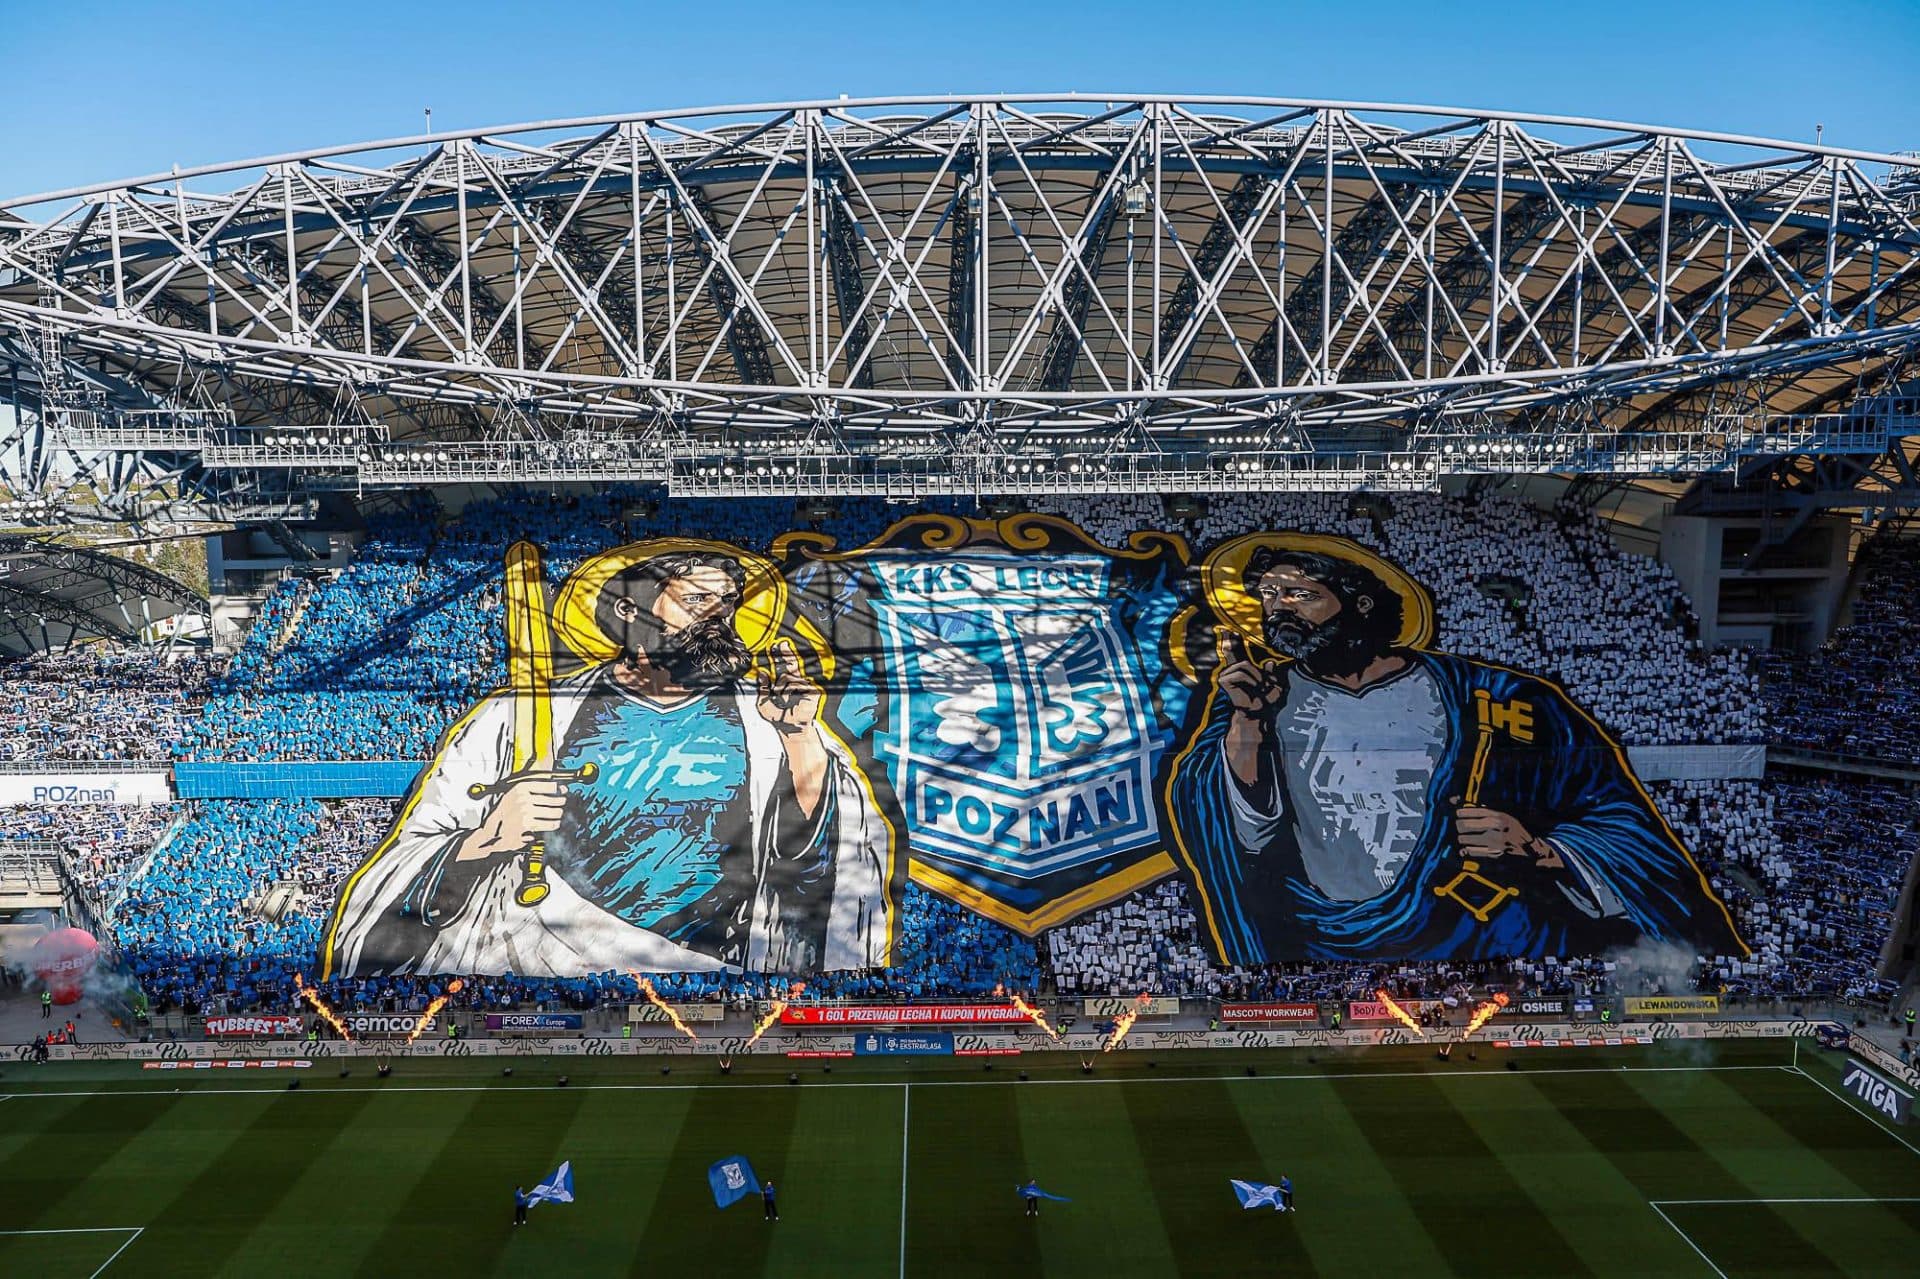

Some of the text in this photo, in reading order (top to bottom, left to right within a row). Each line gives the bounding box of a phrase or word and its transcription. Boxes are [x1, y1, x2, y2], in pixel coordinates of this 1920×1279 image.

[895, 563, 1096, 594] KKS LECH
[923, 774, 1132, 850] POZNAŃ
[1264, 1008, 1314, 1017] WORKWEAR
[1522, 1002, 1563, 1012] OSHEE
[1638, 999, 1717, 1010] LEWANDOWSKA
[546, 1018, 567, 1027] Europe
[817, 1010, 825, 1021] 1
[825, 1010, 846, 1021] GOL
[847, 1009, 900, 1021] PRZEWAGI
[900, 1009, 932, 1020] LECHA
[933, 1009, 939, 1020] I
[940, 1009, 974, 1020] KUPON
[207, 1017, 273, 1034] TUBBEES
[581, 1037, 616, 1055] Pils
[1237, 1030, 1273, 1047] Pils
[157, 1041, 192, 1059] Pils
[299, 1040, 336, 1057] Pils
[439, 1039, 475, 1056] Pils
[1843, 1068, 1898, 1119] STIGA
